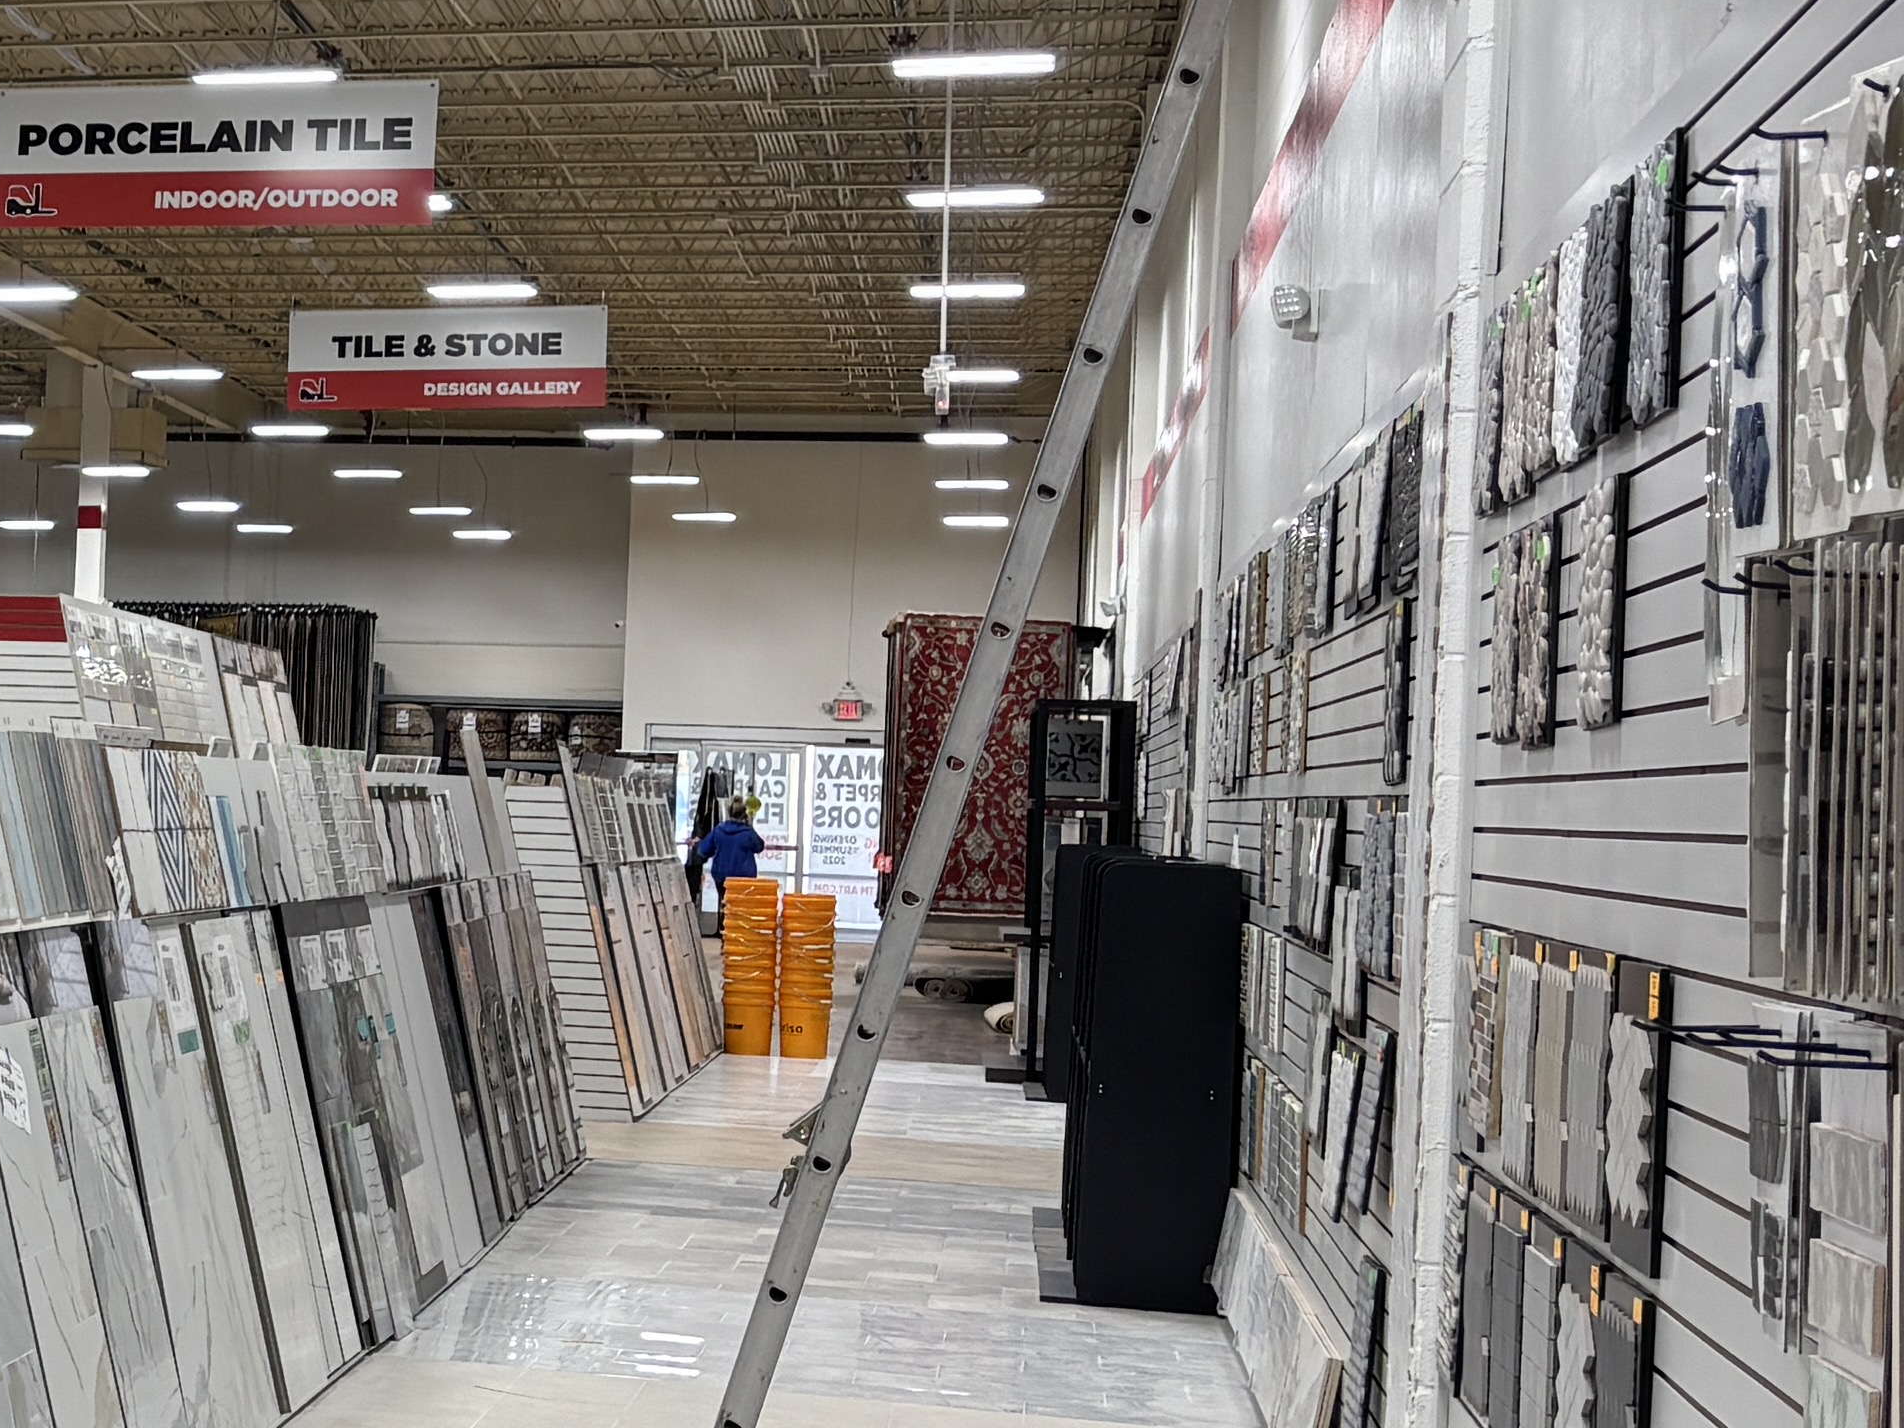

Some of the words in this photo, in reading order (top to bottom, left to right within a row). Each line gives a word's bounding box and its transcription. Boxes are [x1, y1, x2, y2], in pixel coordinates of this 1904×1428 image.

[17, 118, 293, 157] PORCELAIN
[306, 117, 414, 153] TILE
[153, 186, 399, 212] INDOOR/OUTDOOR
[331, 335, 407, 360] TILE
[412, 333, 436, 359] &
[444, 331, 563, 358] STONE
[423, 380, 491, 398] DESIGN
[495, 379, 582, 397] GALLERY
